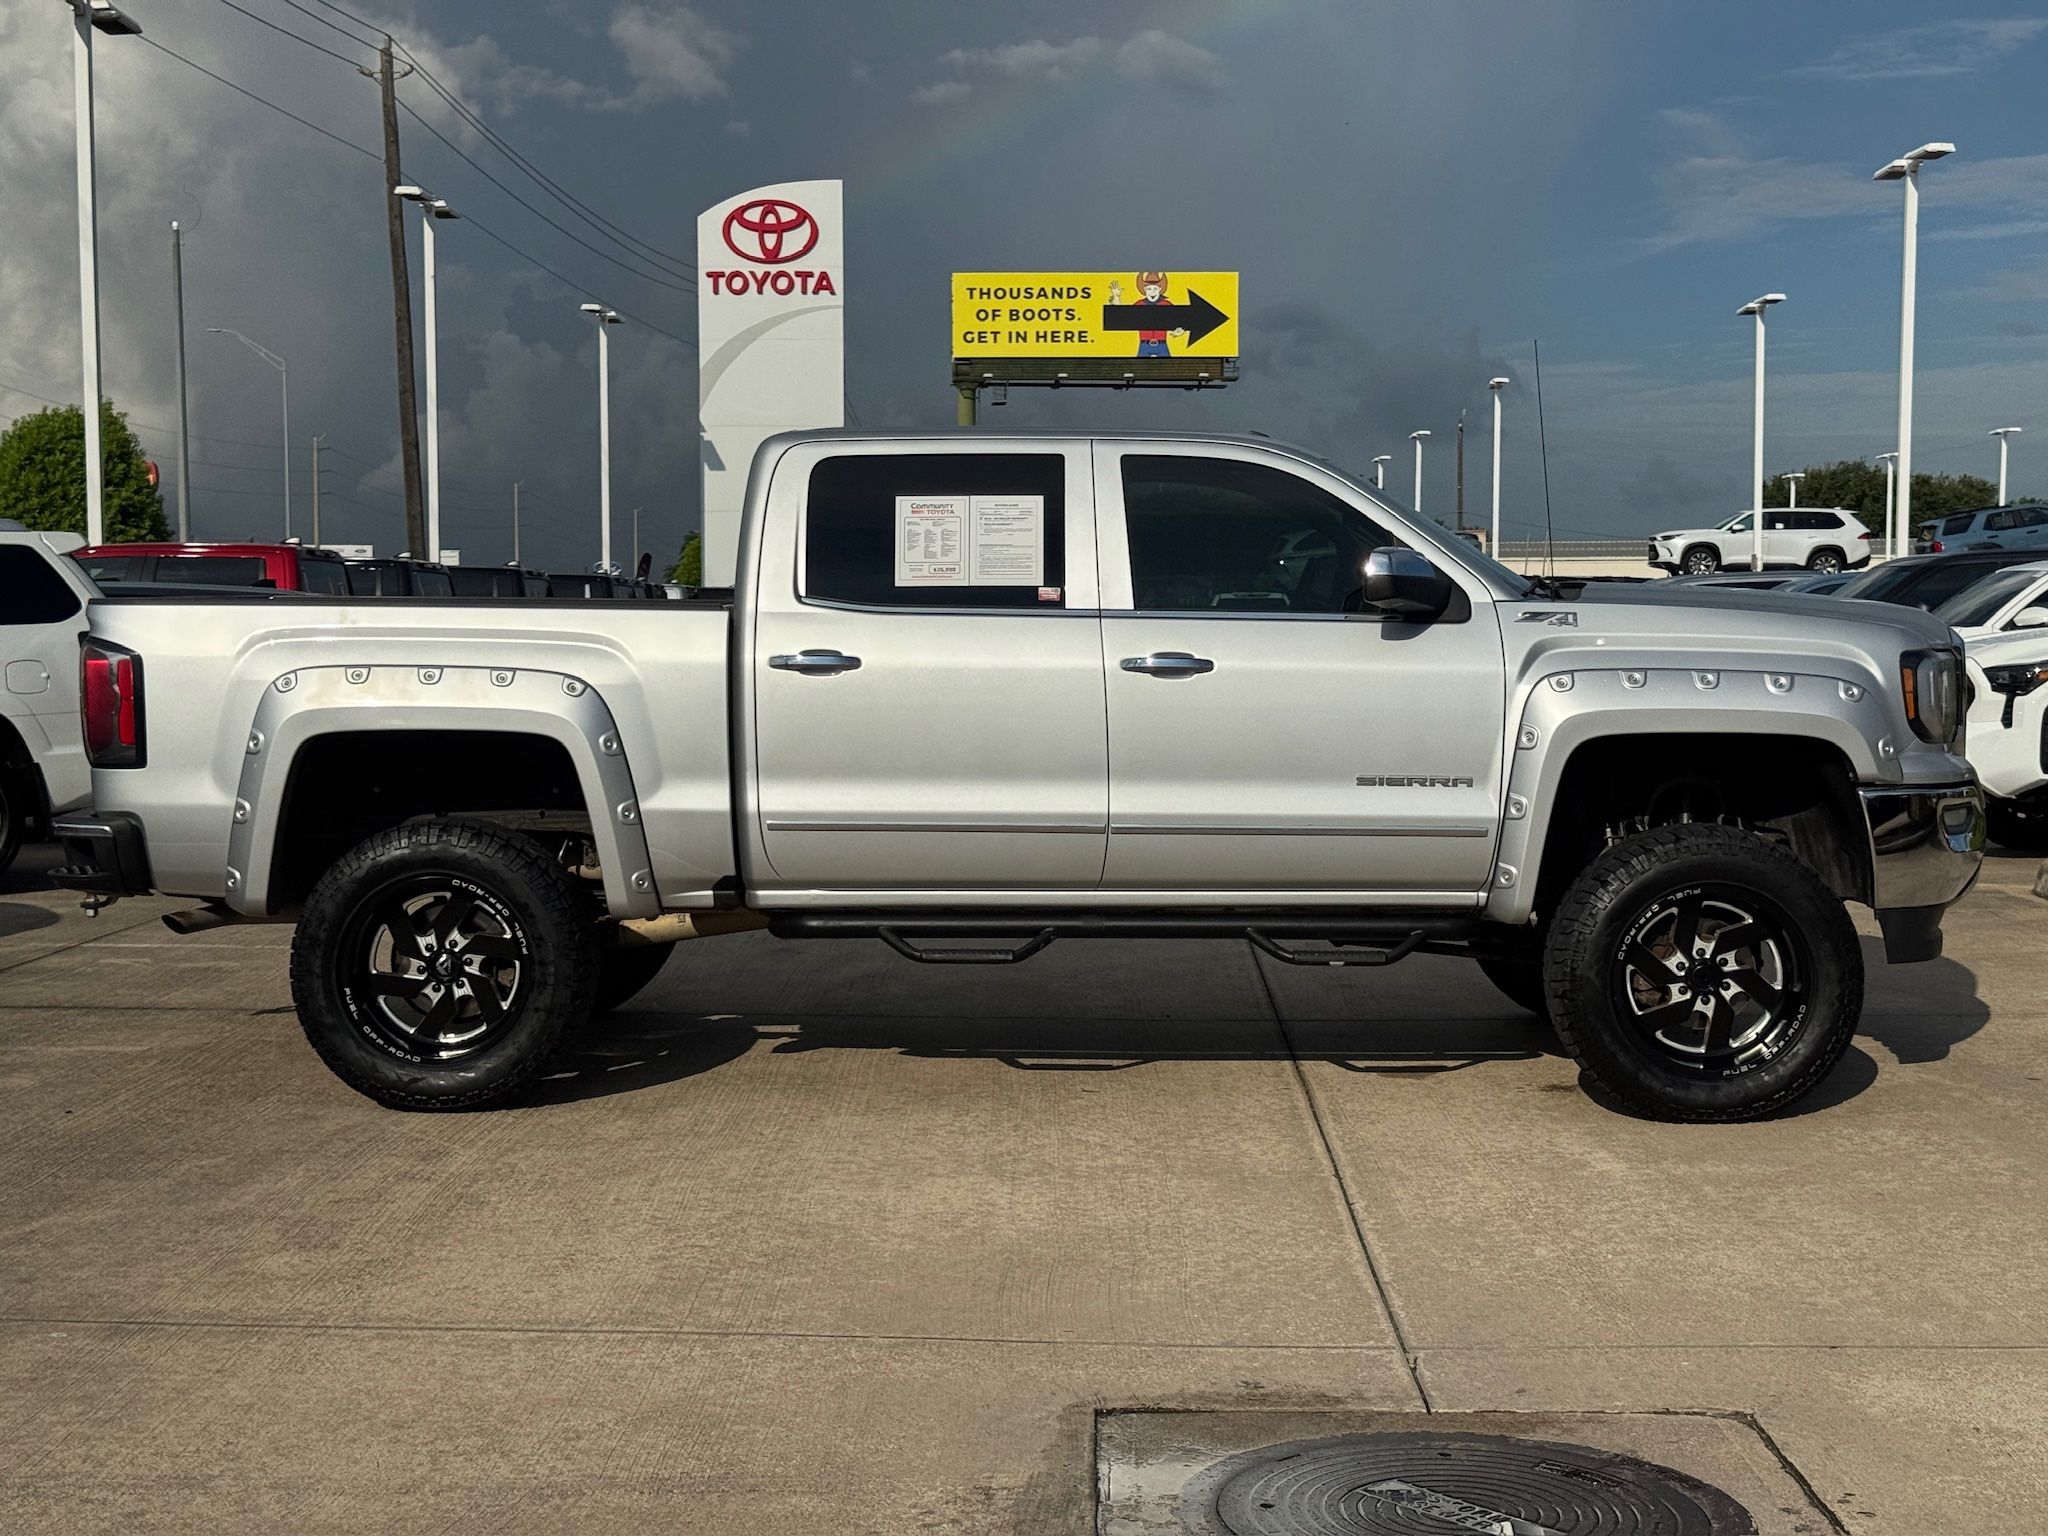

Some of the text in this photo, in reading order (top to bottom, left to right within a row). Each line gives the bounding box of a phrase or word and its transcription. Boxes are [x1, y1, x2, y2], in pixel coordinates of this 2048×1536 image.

[705, 270, 837, 296] TOYOTA
[966, 287, 1092, 300] THOUSANDS
[975, 308, 1082, 322] OF BOOTS.
[963, 331, 1095, 344] GET IN HERE.
[1356, 775, 1474, 788] SIERRA
[1666, 888, 1702, 901] FUEL
[514, 921, 529, 955] FUEL
[343, 987, 359, 1020] FUEL
[1722, 1063, 1758, 1077] FUEL
